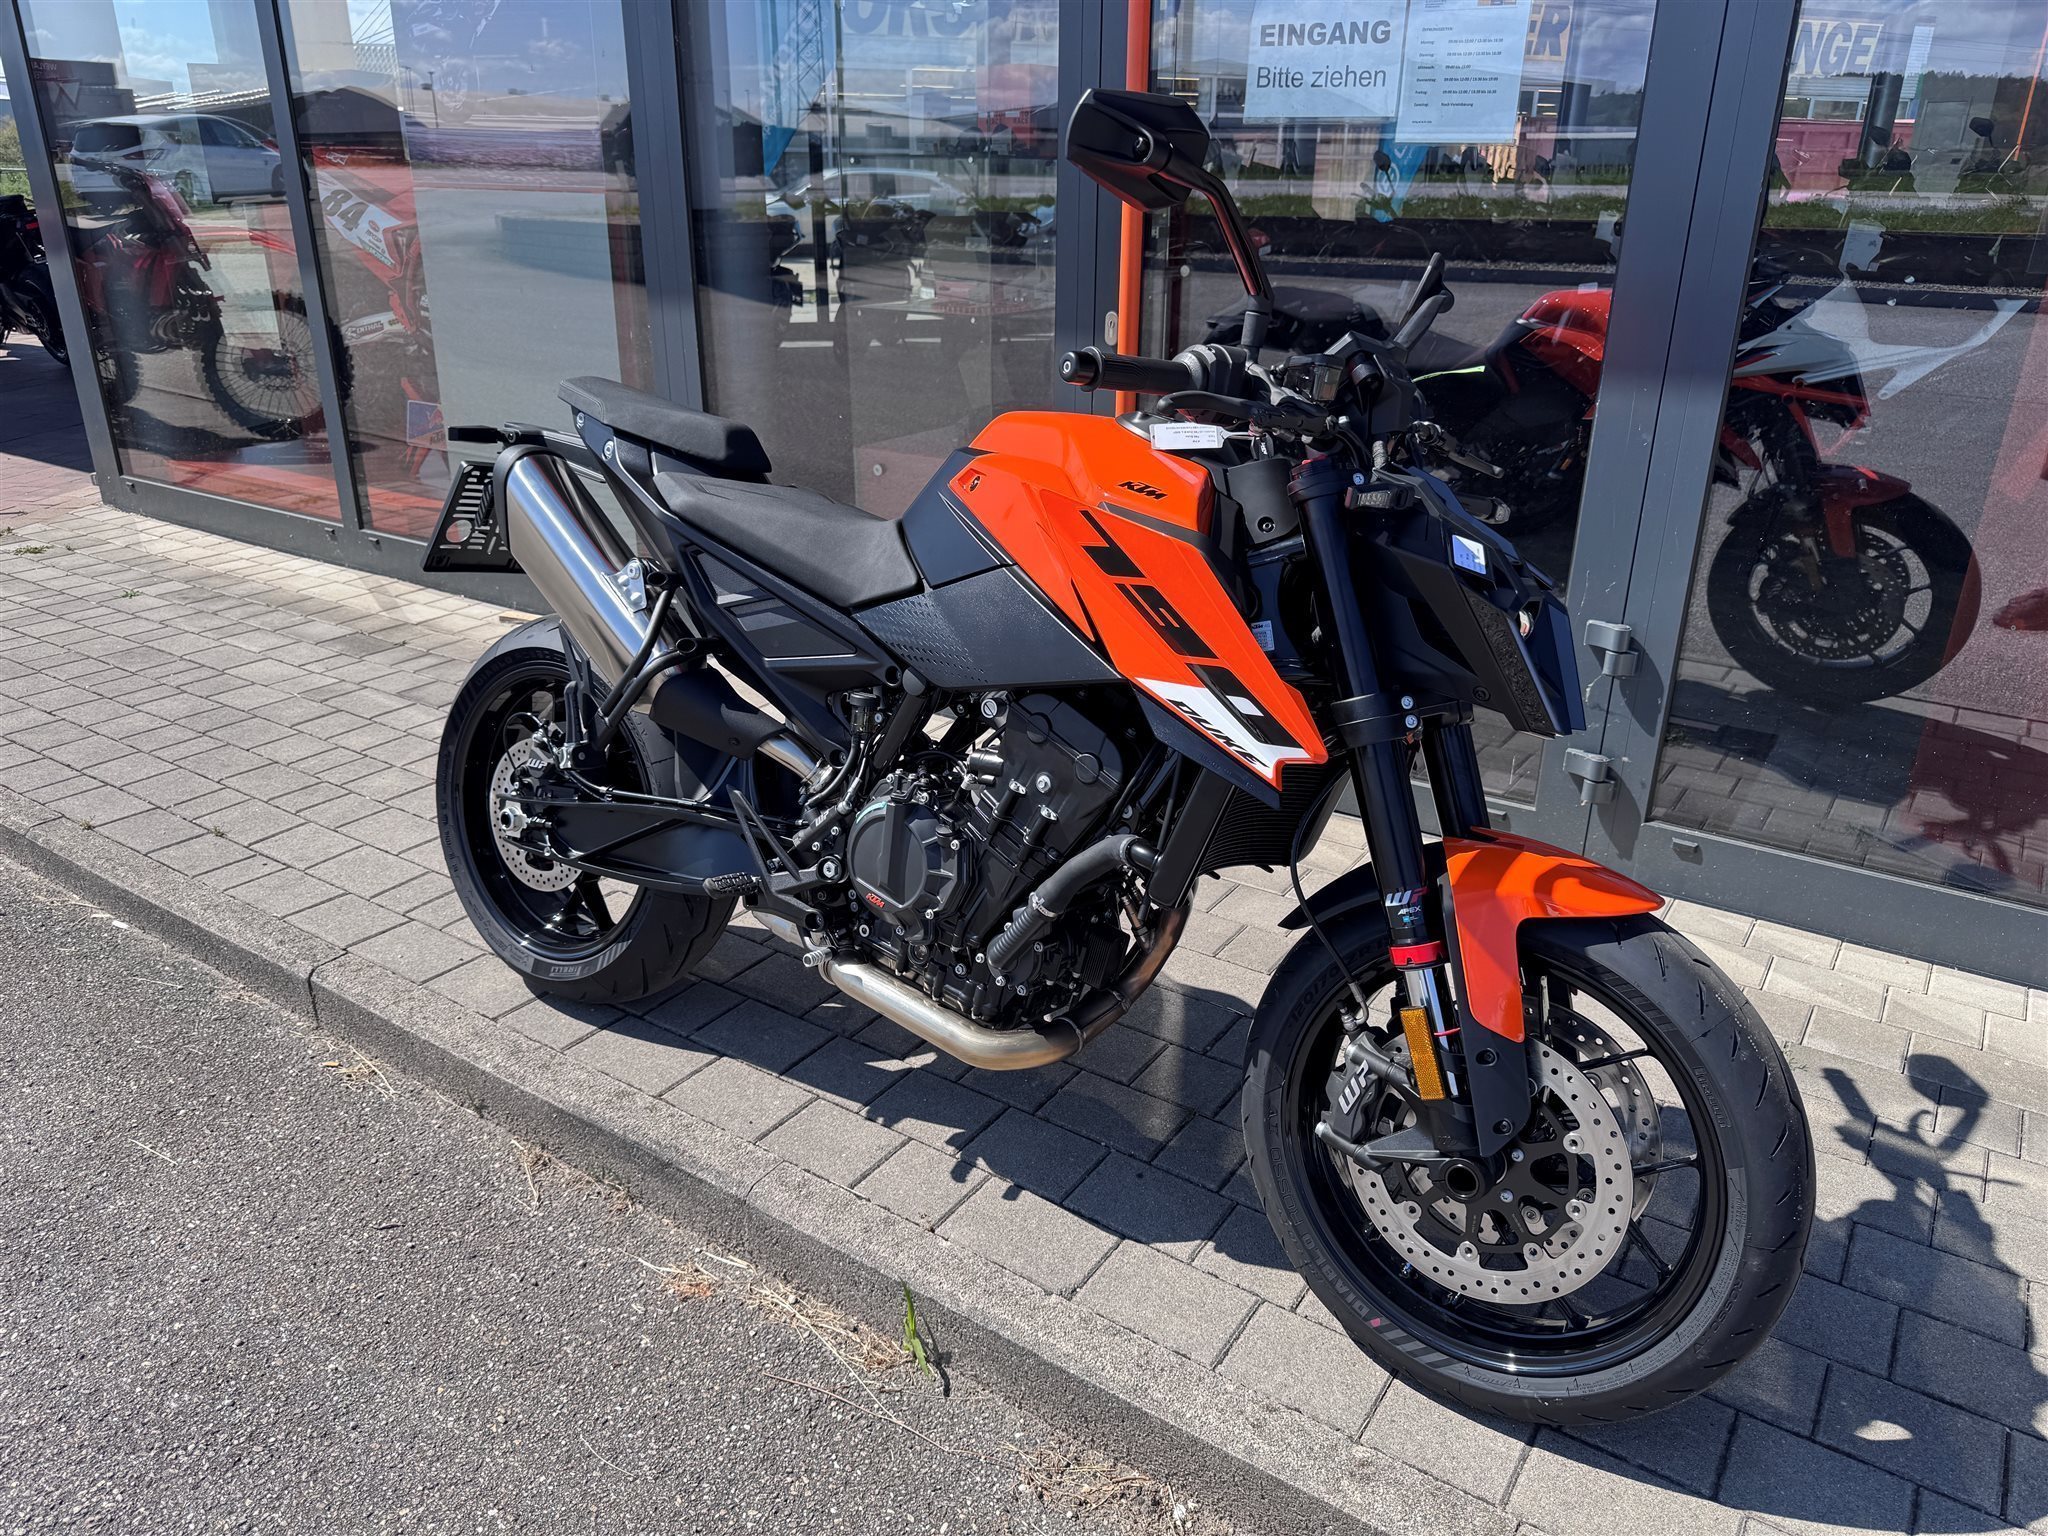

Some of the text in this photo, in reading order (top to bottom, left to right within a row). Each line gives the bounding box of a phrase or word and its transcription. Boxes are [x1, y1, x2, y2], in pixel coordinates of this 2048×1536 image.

[1259, 20, 1391, 47] EINGANG
[1793, 22, 1879, 76] NGE
[1256, 65, 1387, 88] Bitte ziehen
[321, 189, 370, 232] 84
[1117, 481, 1168, 500] KTM
[1078, 510, 1304, 749] 790
[1165, 698, 1271, 769] DUKE
[865, 892, 886, 908] KTM
[1385, 886, 1429, 906] WP
[1397, 905, 1422, 916] APEX
[1338, 1059, 1369, 1115] WP
[1270, 1147, 1304, 1226] ROSSO
[1302, 1232, 1370, 1319] DIABLO
